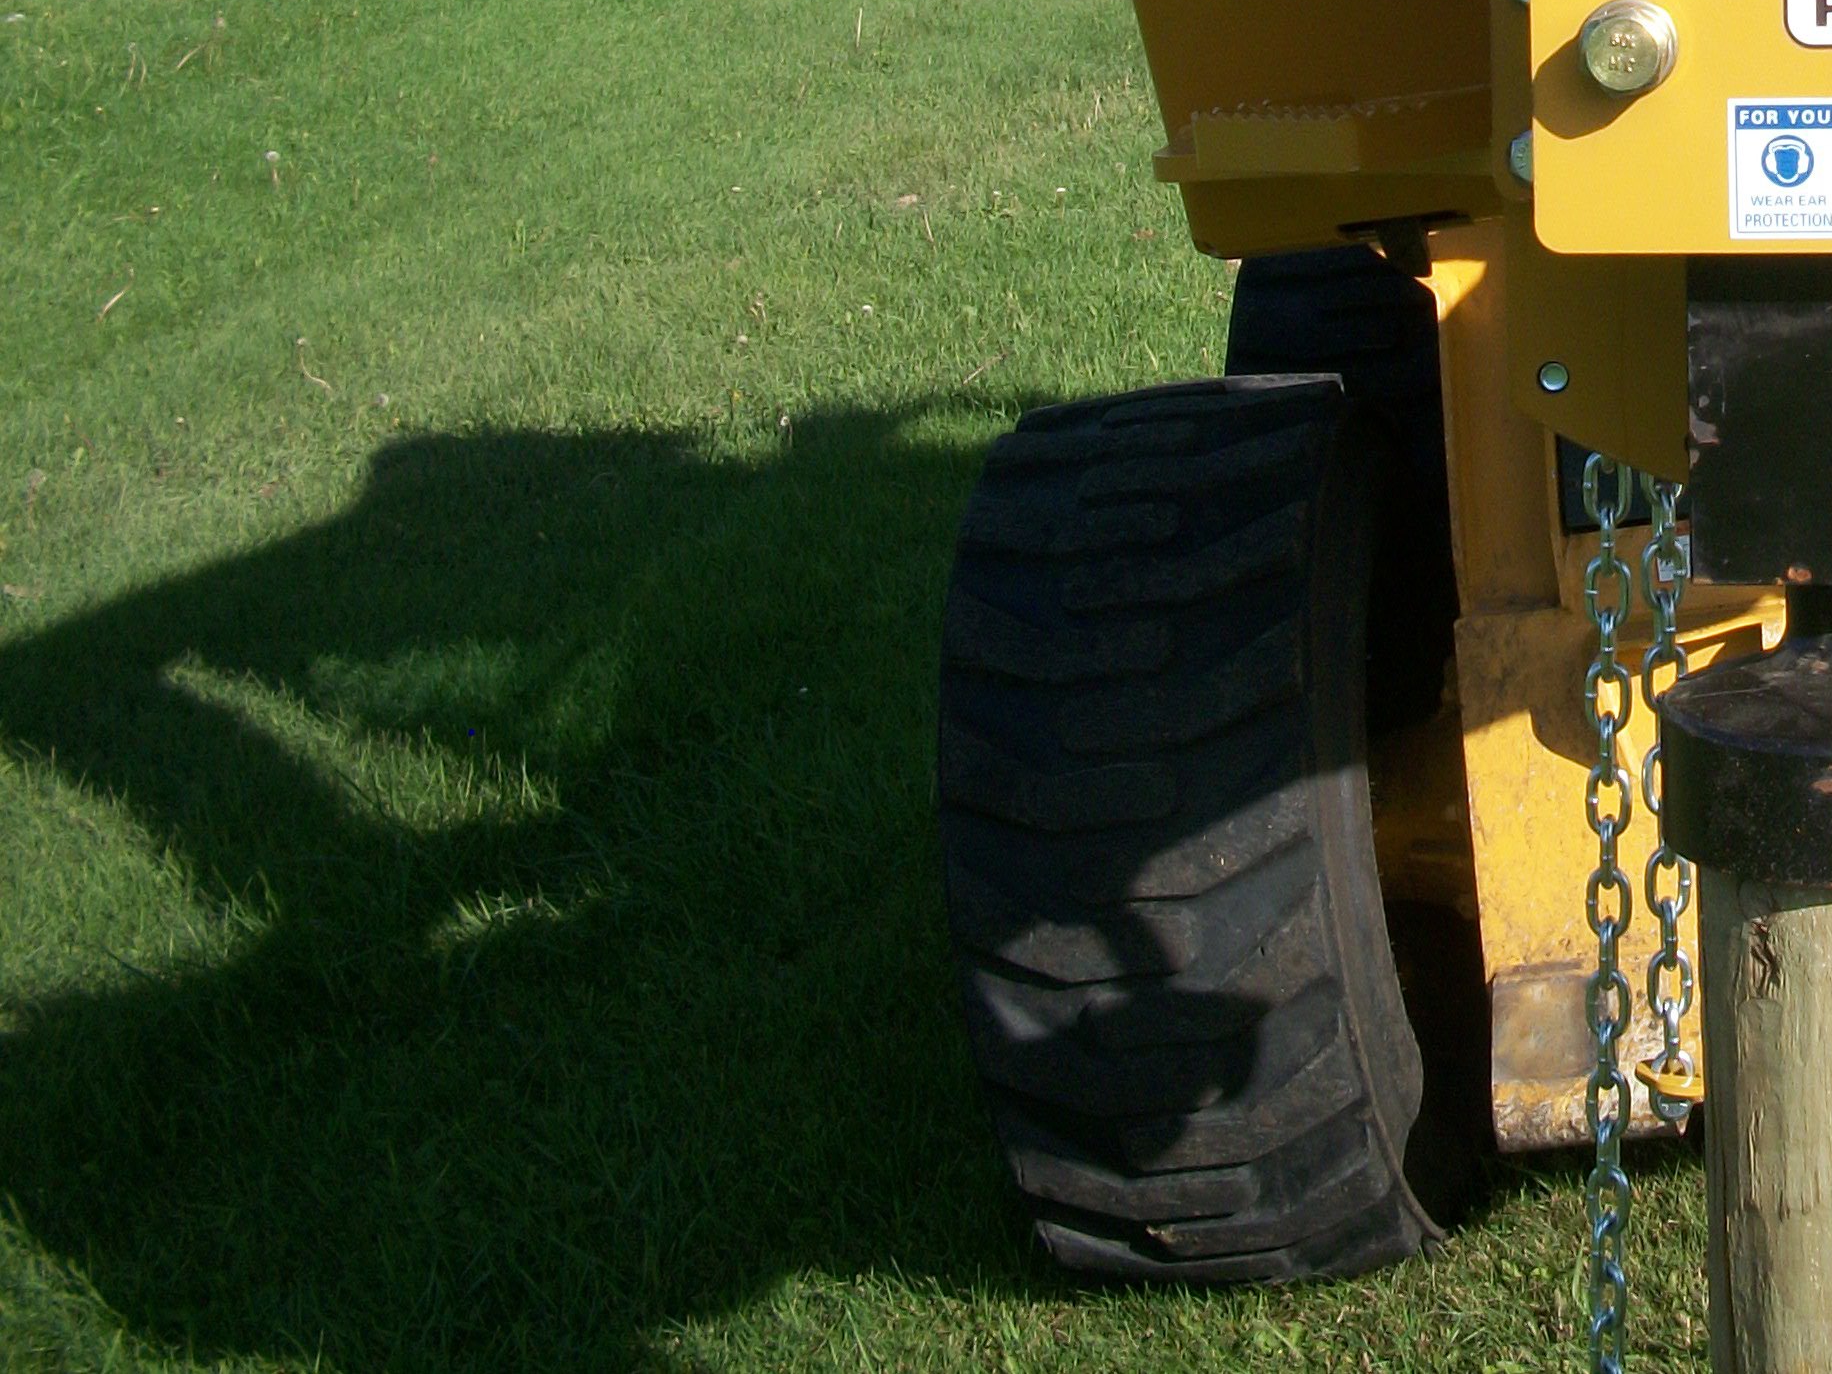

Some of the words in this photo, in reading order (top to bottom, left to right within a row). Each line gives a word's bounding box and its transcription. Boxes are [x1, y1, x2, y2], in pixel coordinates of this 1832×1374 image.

[1739, 109, 1779, 125] FOR
[1750, 194, 1794, 206] WEAR
[1798, 194, 1827, 206] EAR
[1745, 213, 1832, 227] PROTECTION
